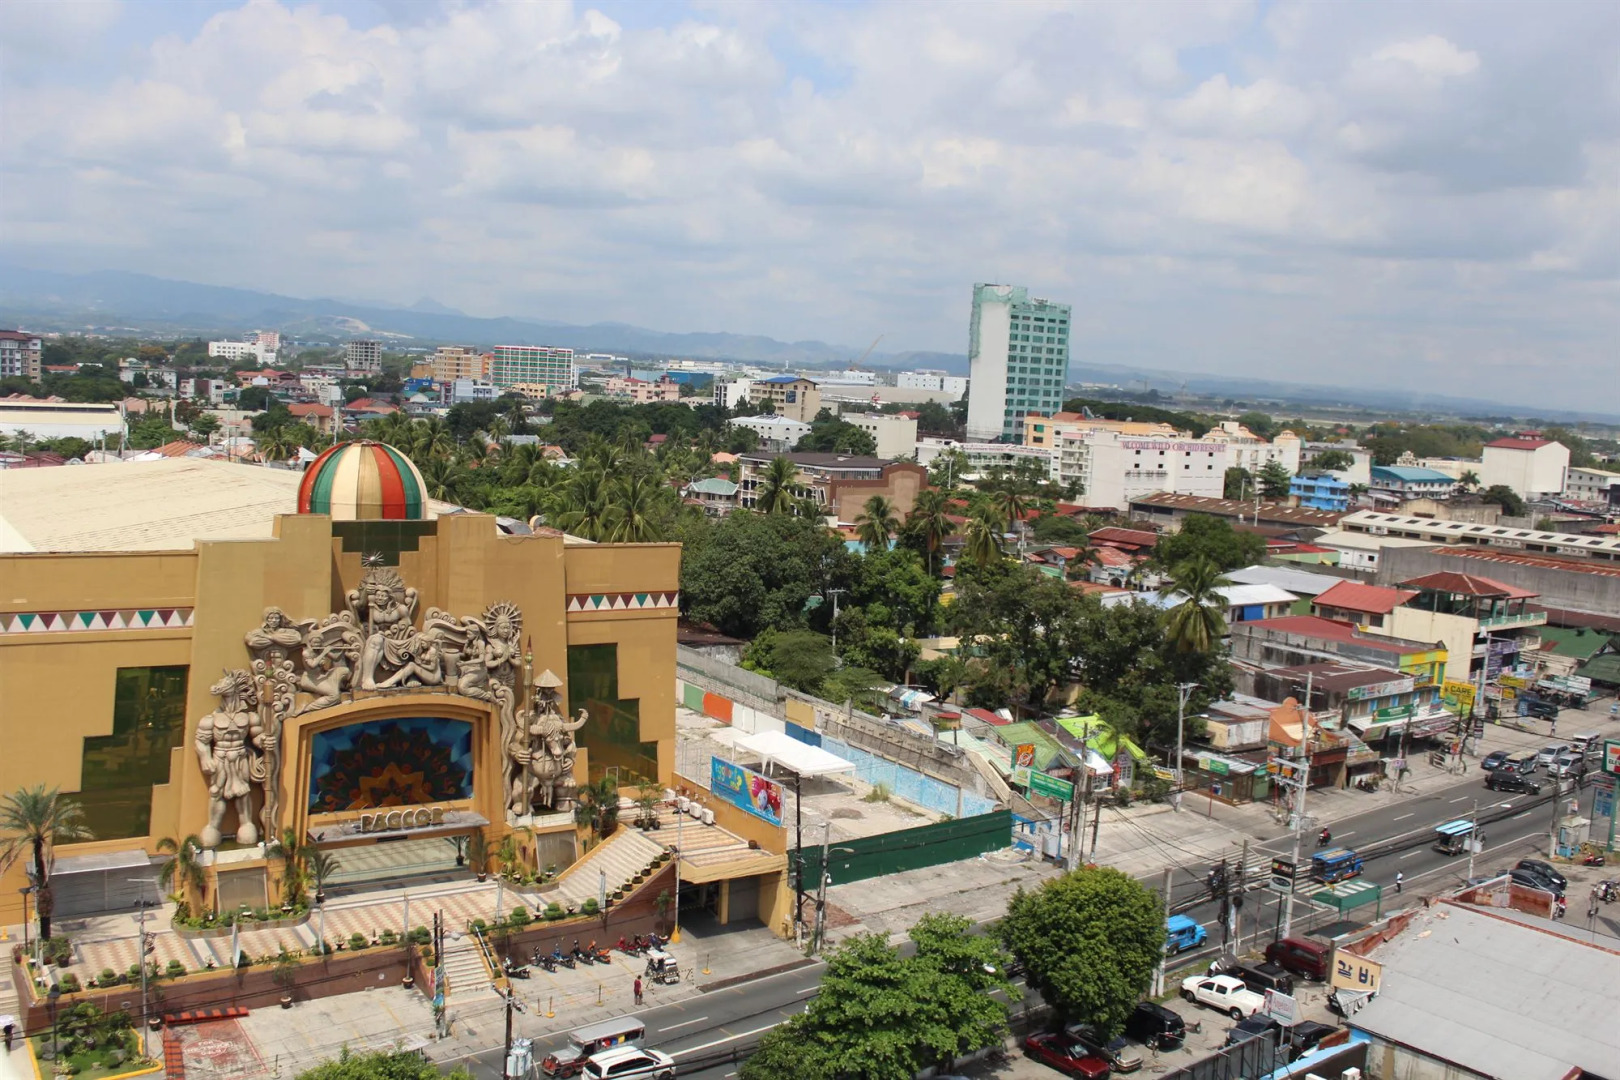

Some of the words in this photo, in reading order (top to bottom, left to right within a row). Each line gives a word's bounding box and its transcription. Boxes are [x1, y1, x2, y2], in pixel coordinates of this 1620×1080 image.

[1151, 441, 1170, 451] WILD
[1450, 685, 1472, 695] CARE
[1338, 960, 1374, 986] 갈비
